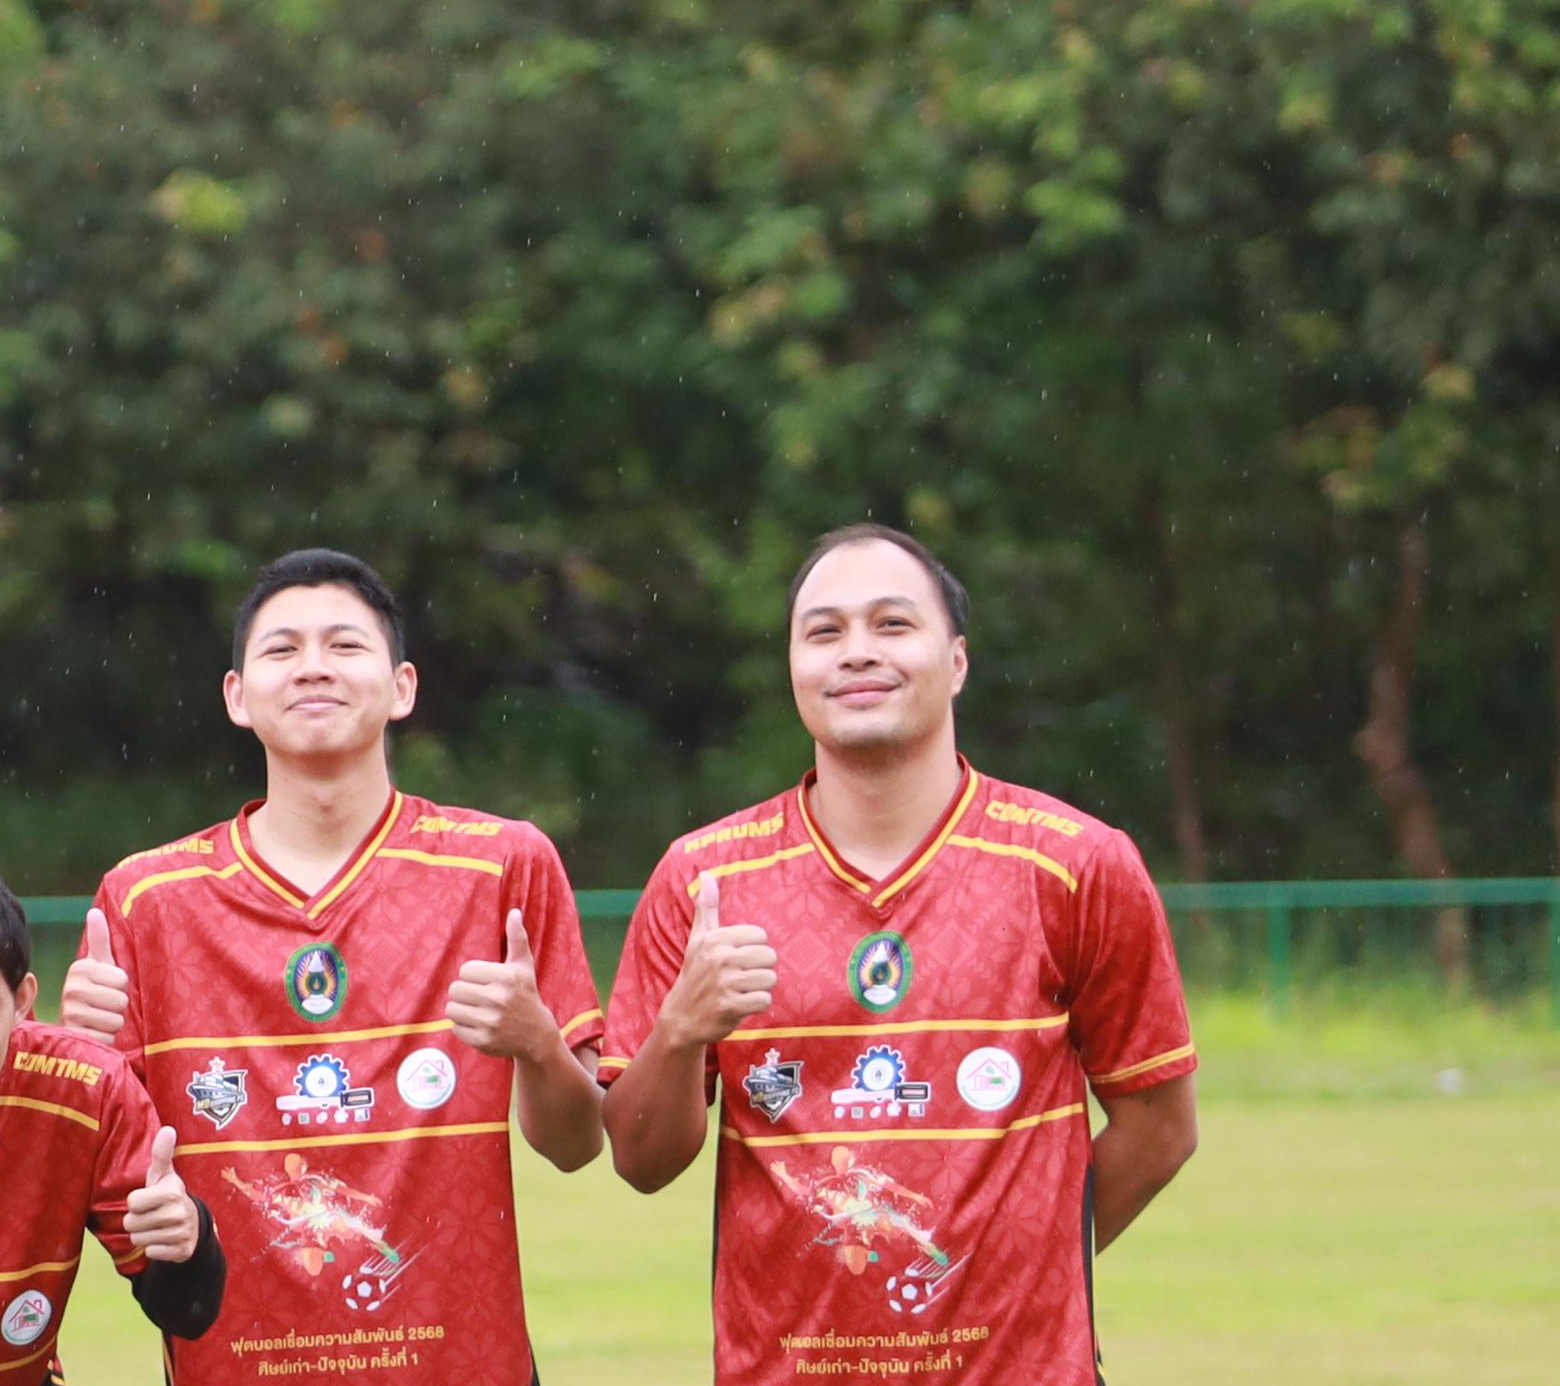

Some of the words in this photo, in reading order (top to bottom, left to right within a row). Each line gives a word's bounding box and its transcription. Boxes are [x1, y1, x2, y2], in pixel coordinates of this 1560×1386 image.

[408, 1325, 445, 1340] 2568
[952, 1326, 989, 1343] 2568
[411, 1353, 419, 1365] 1
